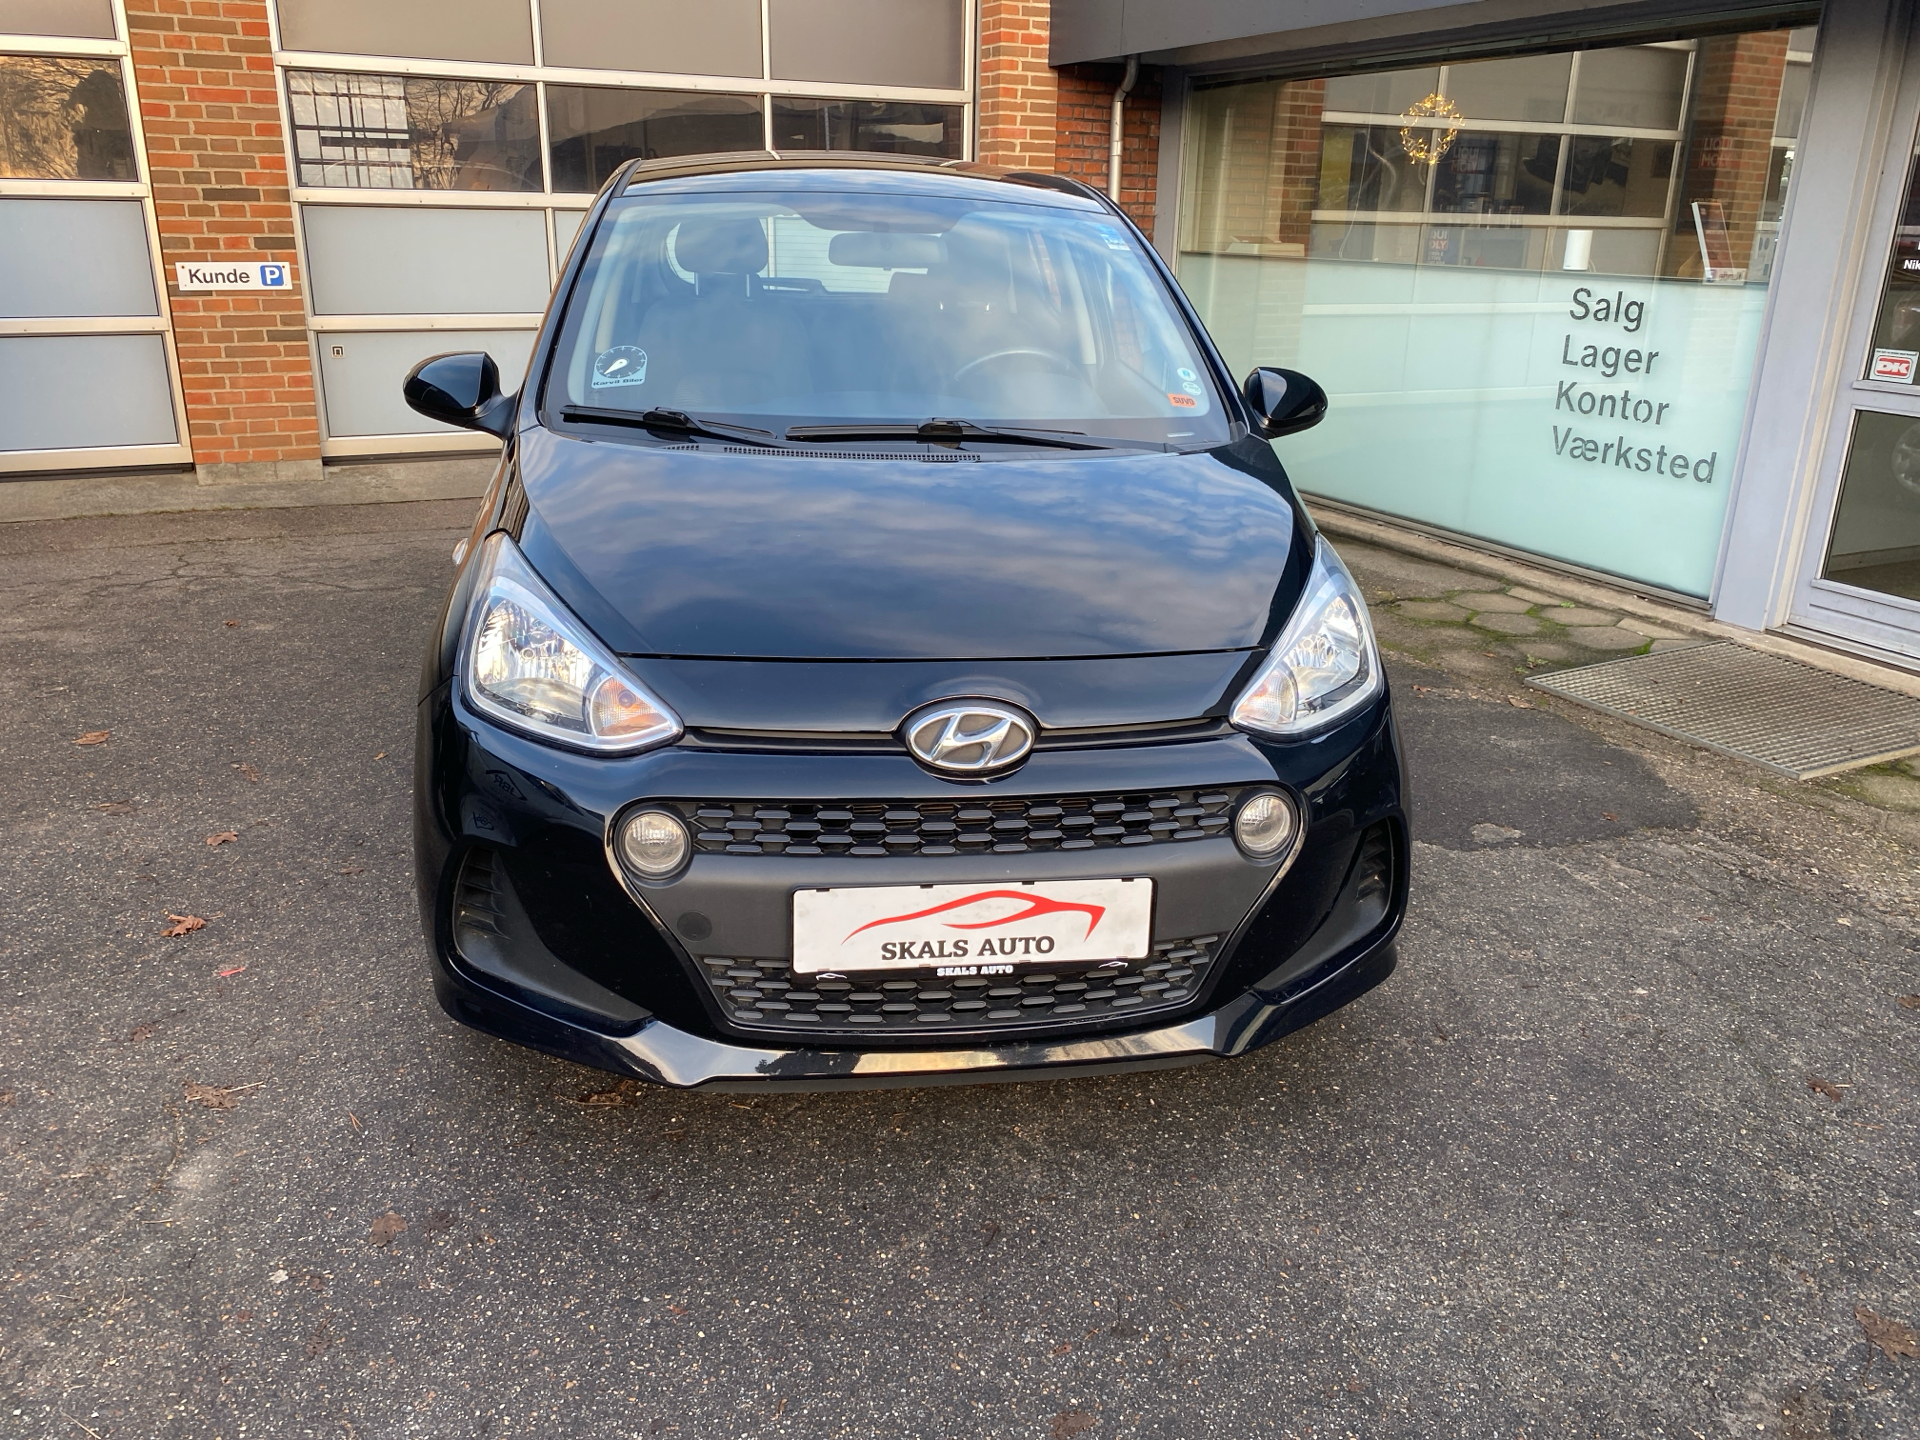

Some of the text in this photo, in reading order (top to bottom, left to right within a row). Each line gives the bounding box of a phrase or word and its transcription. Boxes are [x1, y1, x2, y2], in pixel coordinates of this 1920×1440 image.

[188, 267, 280, 285] Kunde P
[1569, 287, 1645, 333] Salg
[1562, 334, 1660, 378] Lager
[1555, 380, 1670, 425] Kontor
[1552, 425, 1717, 484] Værksted
[881, 935, 1055, 961] SKALS AUTO
[936, 964, 1014, 977] SKALS AUTO
